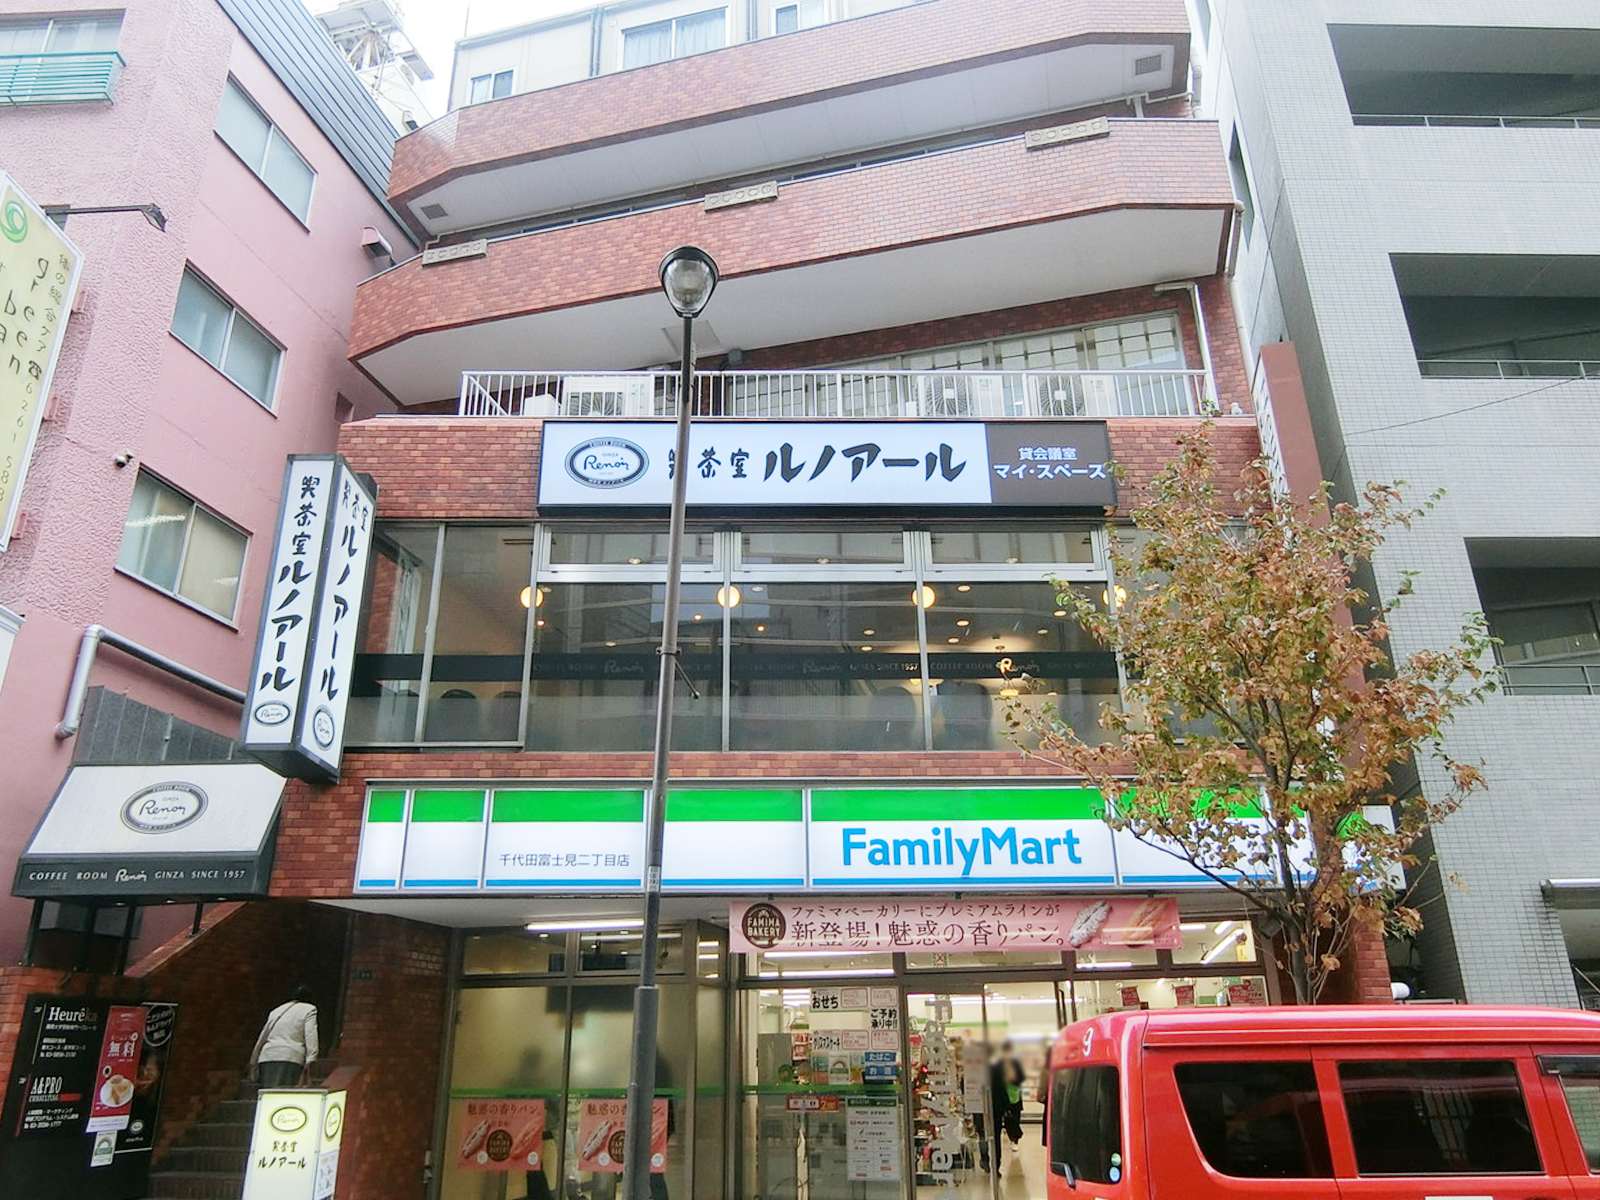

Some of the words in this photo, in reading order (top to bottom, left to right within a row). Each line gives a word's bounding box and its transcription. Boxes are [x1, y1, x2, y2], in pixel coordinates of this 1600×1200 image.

[1018, 447, 1078, 461] 貸会議室
[583, 454, 629, 470] Renoir
[993, 464, 1107, 480] マイ・スペース
[320, 525, 358, 701] ルノアール
[842, 827, 1083, 877] FamilyMart
[499, 852, 630, 869] 千代田富士見二丁目店
[29, 871, 68, 881] COFFEE
[76, 871, 108, 880] ROOM
[154, 870, 184, 879] GINZA
[191, 870, 219, 878] SINCE
[223, 870, 245, 878] 1957
[791, 903, 1060, 918] ファミマベーカリーにプレミアムラインが
[747, 918, 781, 927] FAMIMA
[747, 927, 781, 937] BAKERY
[812, 995, 839, 1009] おせち
[871, 1008, 897, 1019] ご予約
[869, 1053, 891, 1061] たばこ
[30, 1076, 63, 1094] A&PRO
[258, 1157, 307, 1169] ルノアール
